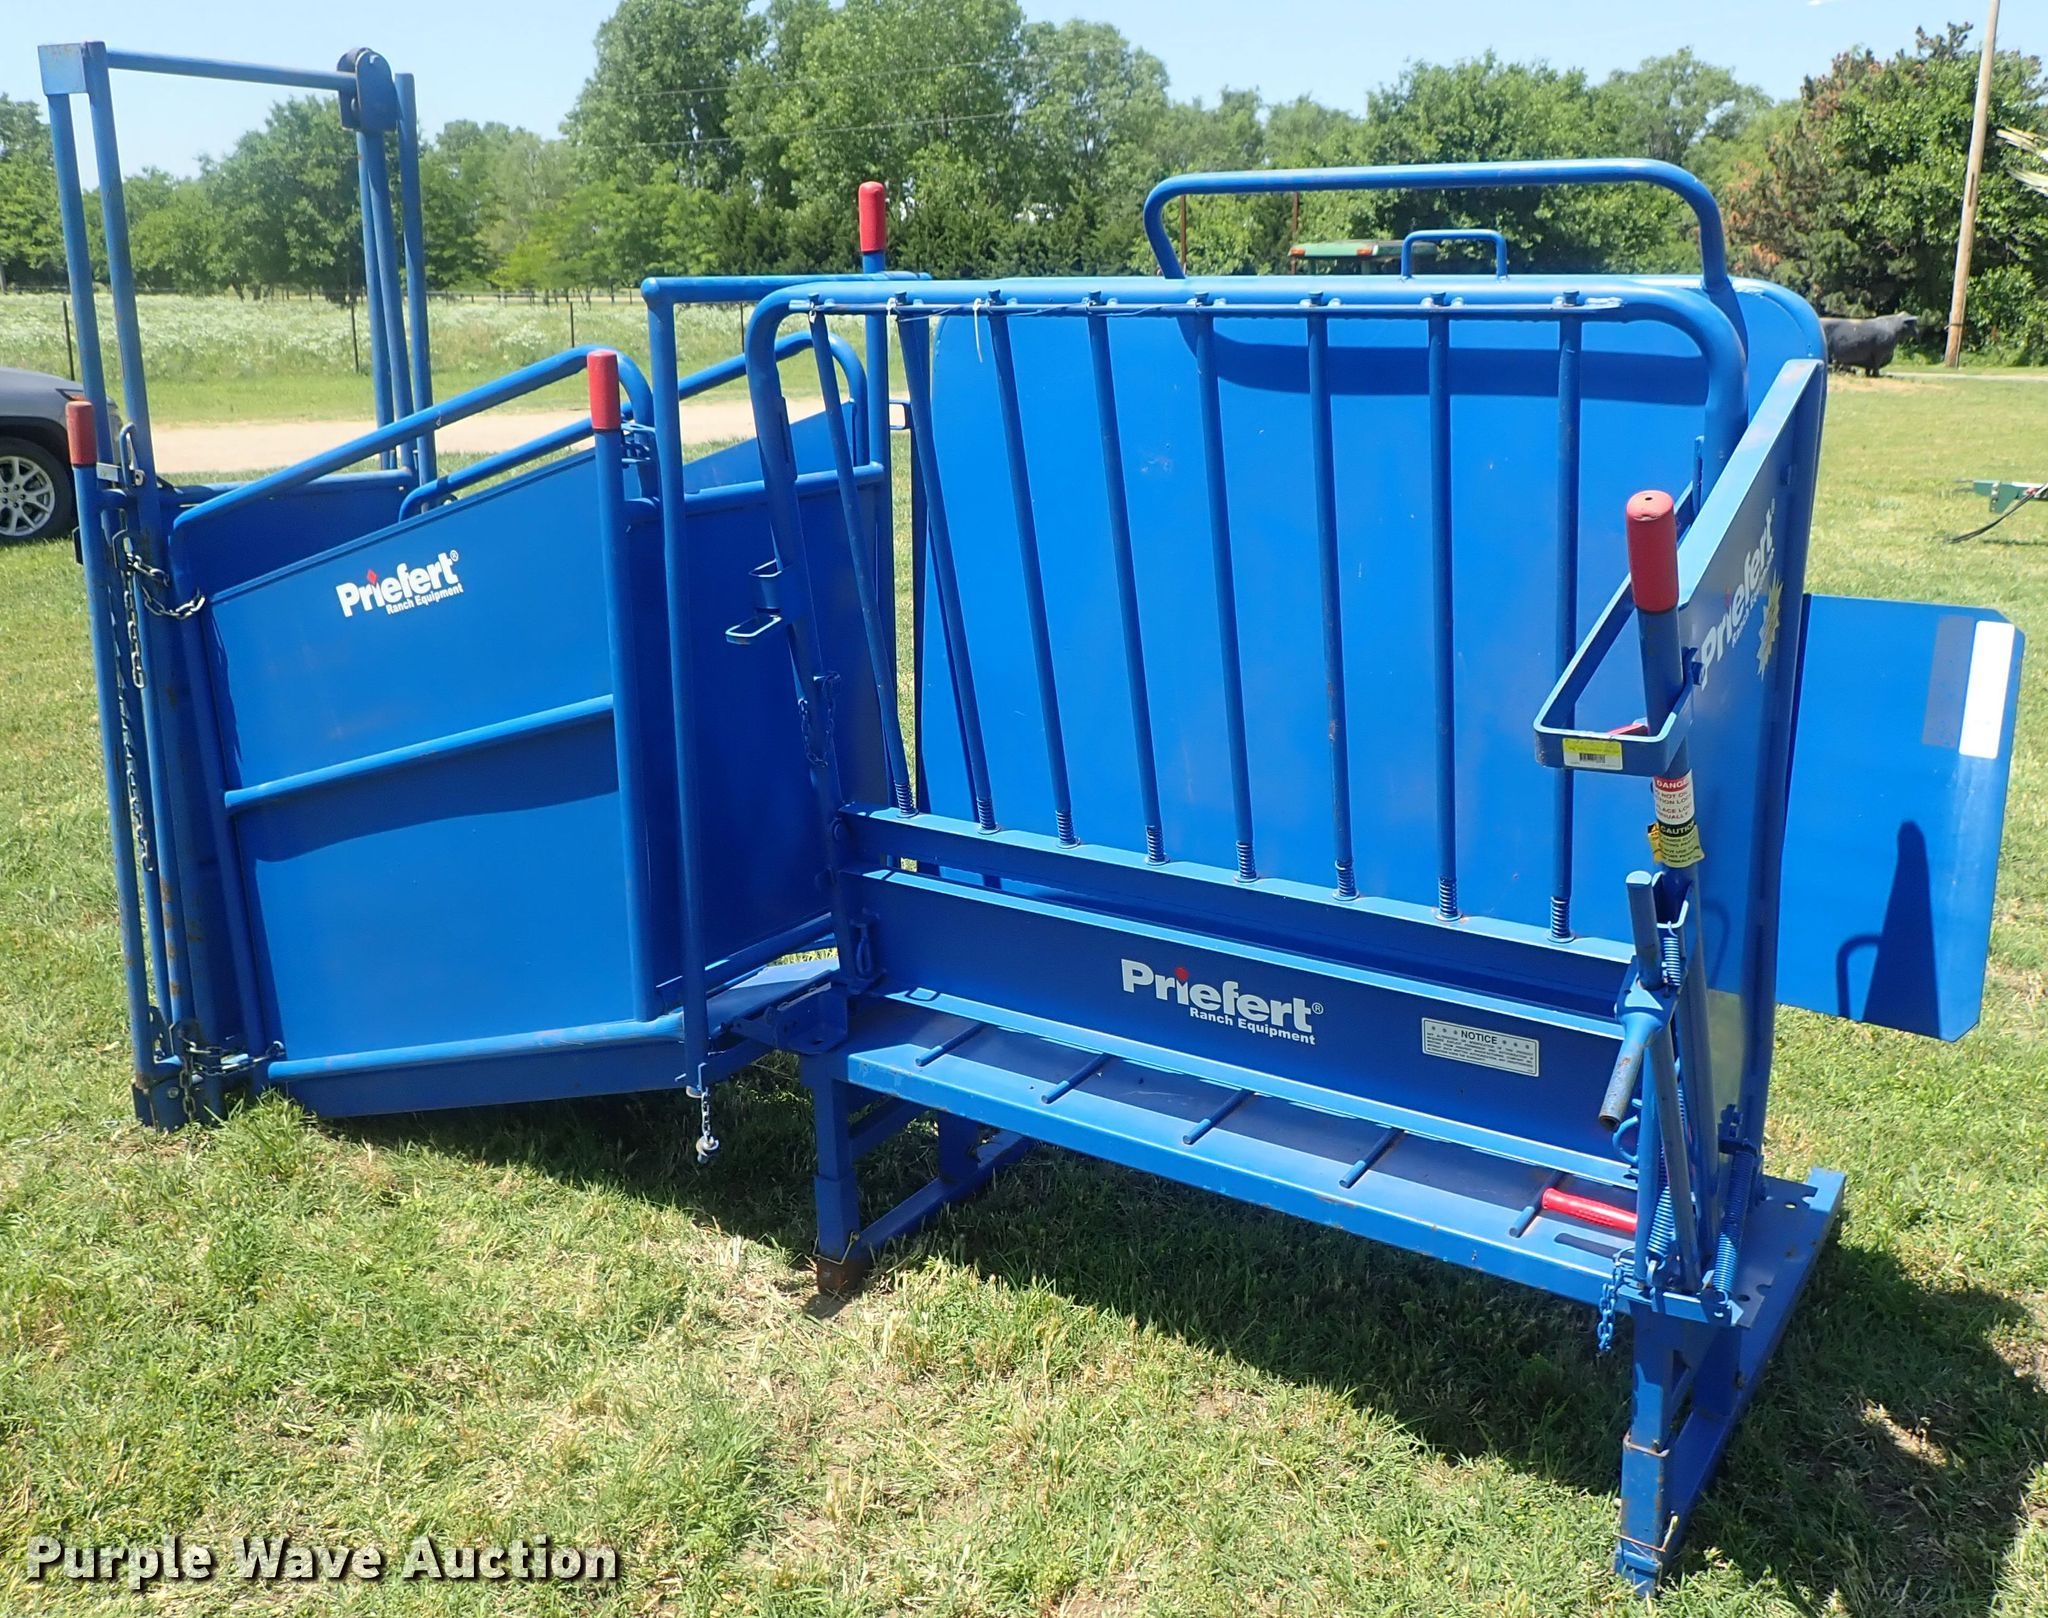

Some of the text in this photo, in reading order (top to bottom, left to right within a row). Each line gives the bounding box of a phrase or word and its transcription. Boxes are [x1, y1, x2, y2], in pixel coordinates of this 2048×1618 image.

[386, 582, 464, 615] Ranch Equipment
[1656, 779, 1688, 789] DANGE
[1190, 1006, 1316, 1045] Ranch Equipment
[1460, 1030, 1498, 1045] NOTICE
